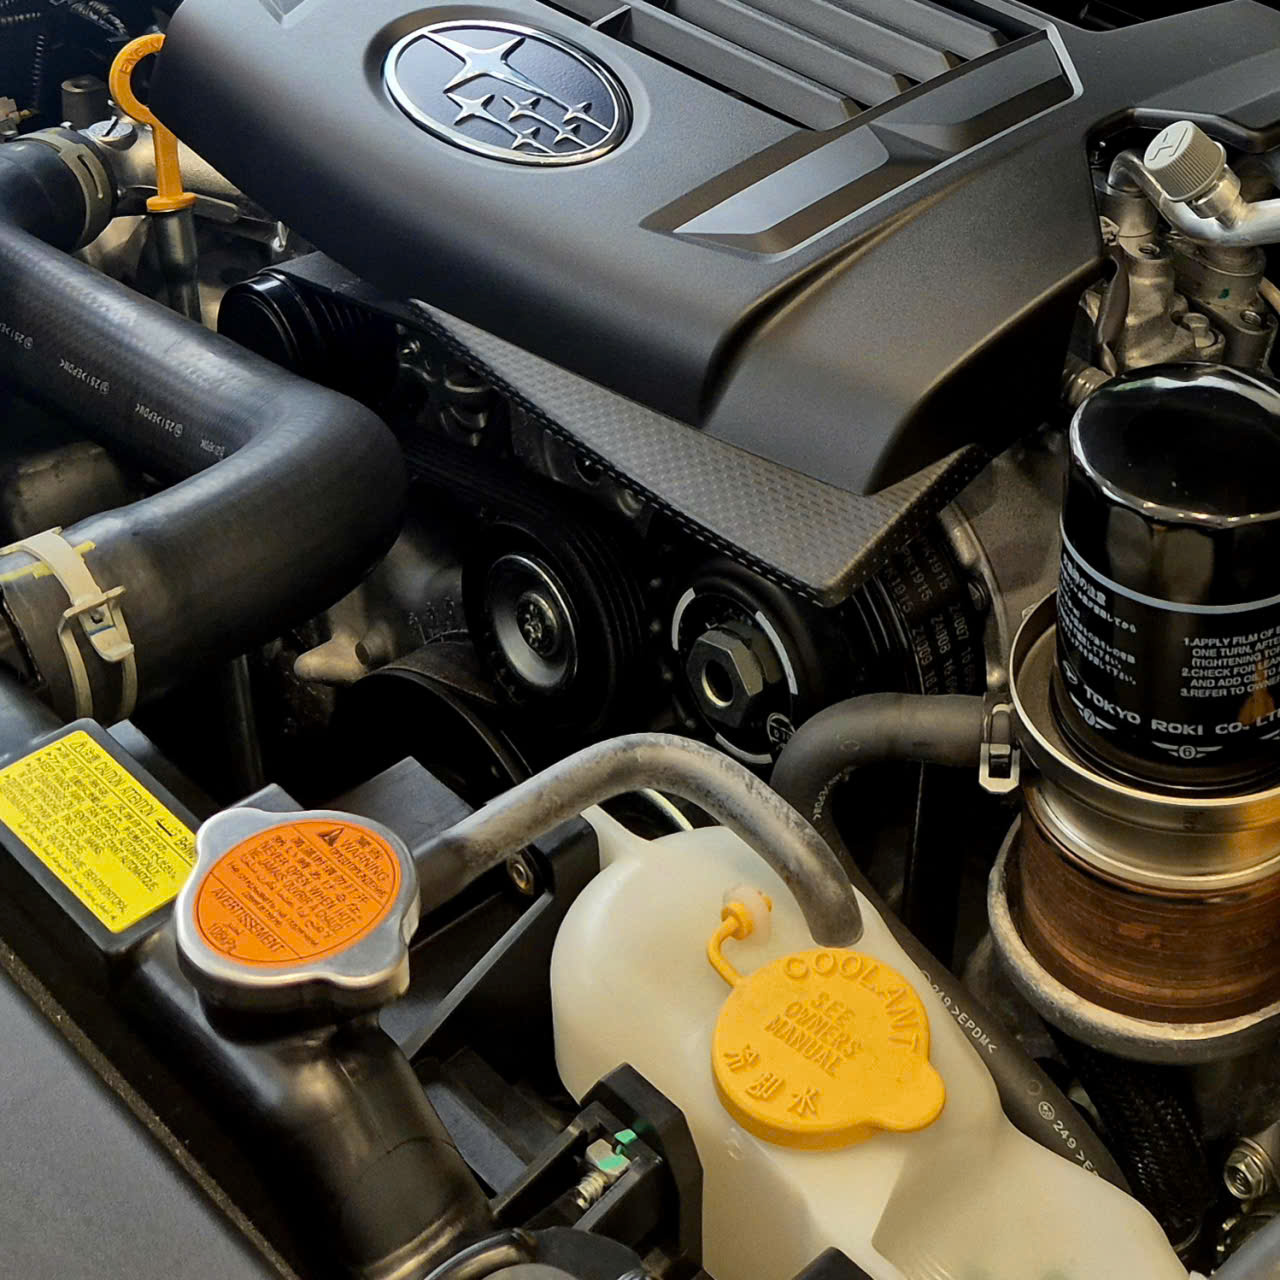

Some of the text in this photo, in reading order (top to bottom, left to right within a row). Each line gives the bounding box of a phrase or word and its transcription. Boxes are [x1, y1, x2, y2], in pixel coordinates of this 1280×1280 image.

[1260, 628, 1274, 639] OF
[1192, 648, 1217, 656] ONE
[1181, 668, 1230, 677] 2.CHECK
[1191, 679, 1215, 687] AND
[1218, 677, 1241, 686] ADD
[1180, 688, 1227, 697] 3.REFER
[1230, 685, 1245, 694] TO
[1084, 684, 1141, 725] TOKYO
[1151, 719, 1203, 736] ROKI
[338, 838, 391, 882] WARNING
[306, 884, 338, 910] WHEN
[209, 885, 286, 953] AVERTISSEMENT
[784, 952, 921, 1054] COOLANT
[811, 992, 855, 1027] SEE
[765, 1016, 842, 1078] MANUAL
[1053, 1120, 1077, 1149] 249
